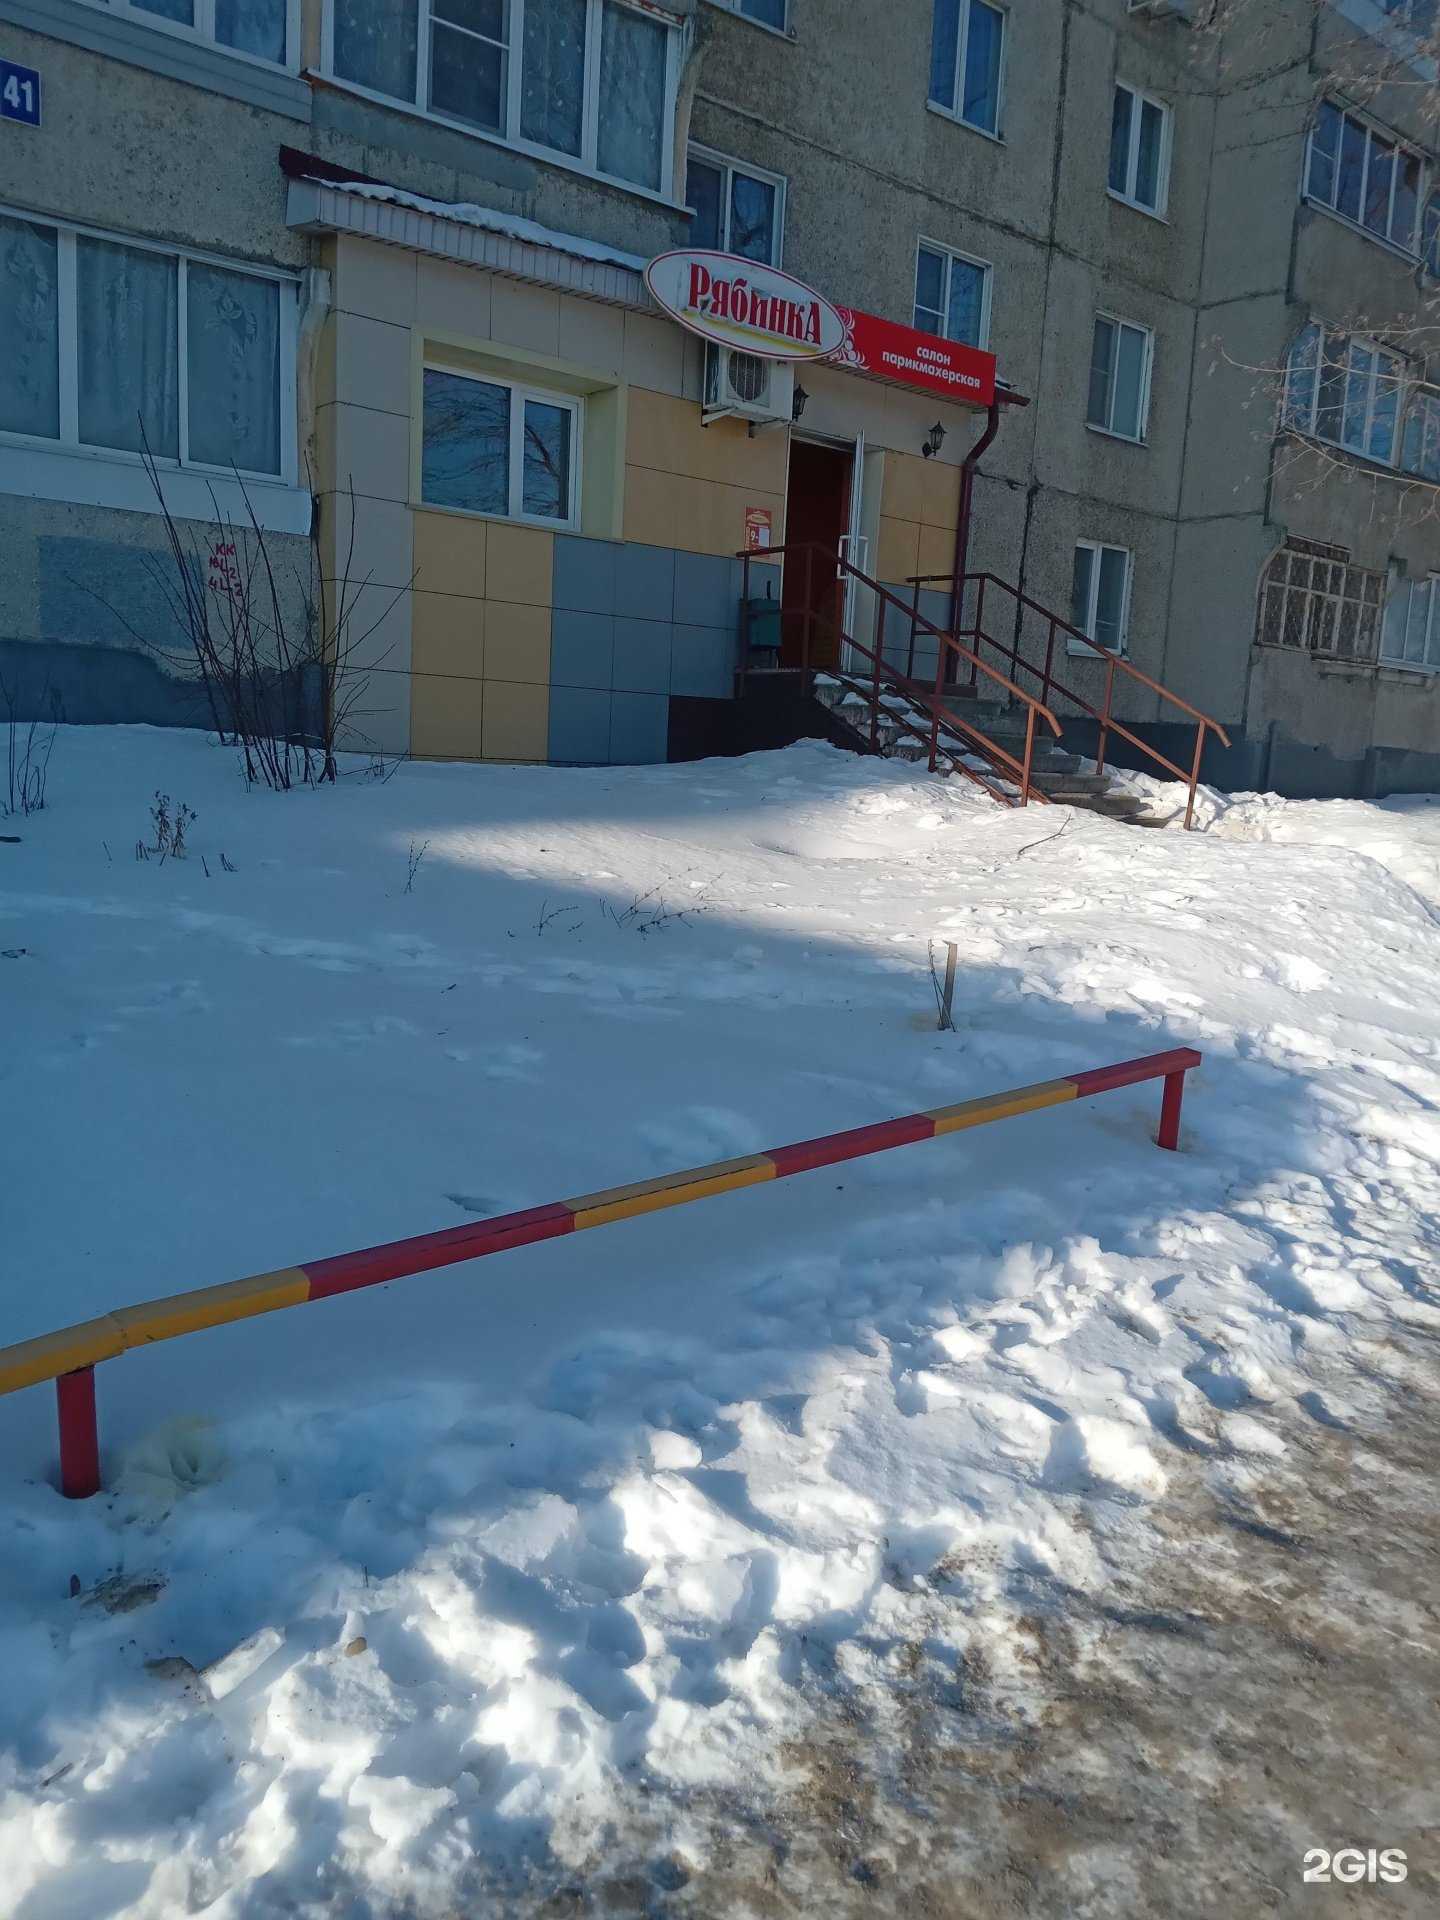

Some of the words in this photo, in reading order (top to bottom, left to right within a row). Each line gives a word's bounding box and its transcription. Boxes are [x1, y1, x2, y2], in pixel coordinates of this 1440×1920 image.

[3, 74, 33, 112] 41
[882, 351, 981, 388] парикмахерская
[916, 346, 951, 366] салон
